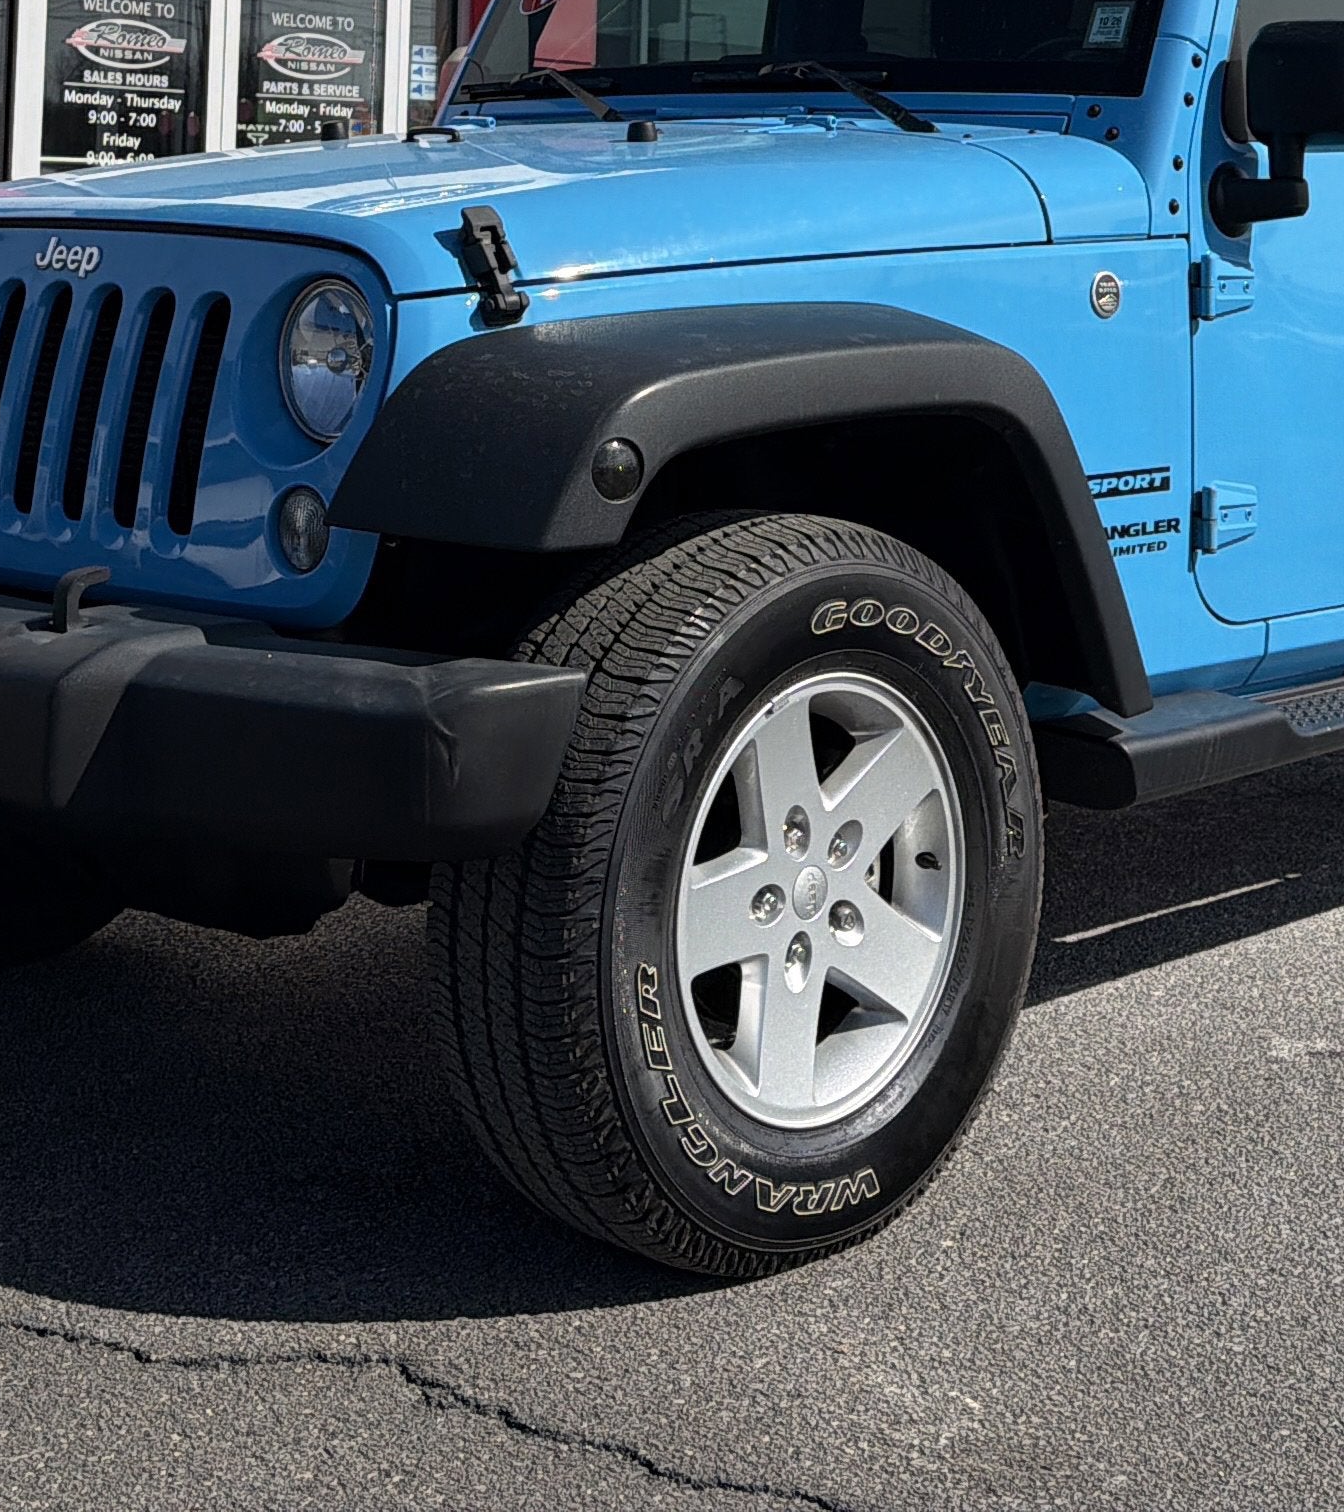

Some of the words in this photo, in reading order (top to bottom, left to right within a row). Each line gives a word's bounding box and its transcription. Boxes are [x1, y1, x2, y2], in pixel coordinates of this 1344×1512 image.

[156, 3, 175, 18] TO
[272, 12, 333, 30] WELCOME
[337, 17, 354, 31] TO
[90, 22, 166, 48] Romeo
[99, 48, 153, 61] NISSAN
[278, 36, 347, 60] Romeo
[287, 61, 336, 72] NISSAN
[83, 70, 122, 84] SALES
[126, 73, 169, 87] HOURS
[263, 81, 298, 94] PARTS
[302, 83, 310, 94] &
[313, 83, 360, 97] SERVICE
[64, 90, 114, 107] Monday
[125, 93, 182, 112] Thursday
[266, 100, 310, 117] Monday
[319, 103, 354, 118] Friday
[88, 110, 117, 125] 9:00
[129, 113, 156, 127] 7:00
[279, 119, 304, 133] 7:00
[103, 133, 141, 149] Friday
[36, 236, 101, 278] Jeep
[1087, 472, 1171, 495] SPORT
[1104, 518, 1181, 541] NGLER
[1113, 541, 1168, 558] IMITED
[810, 598, 1026, 860] GOODYEAR
[637, 961, 881, 1217] WRANGLER
